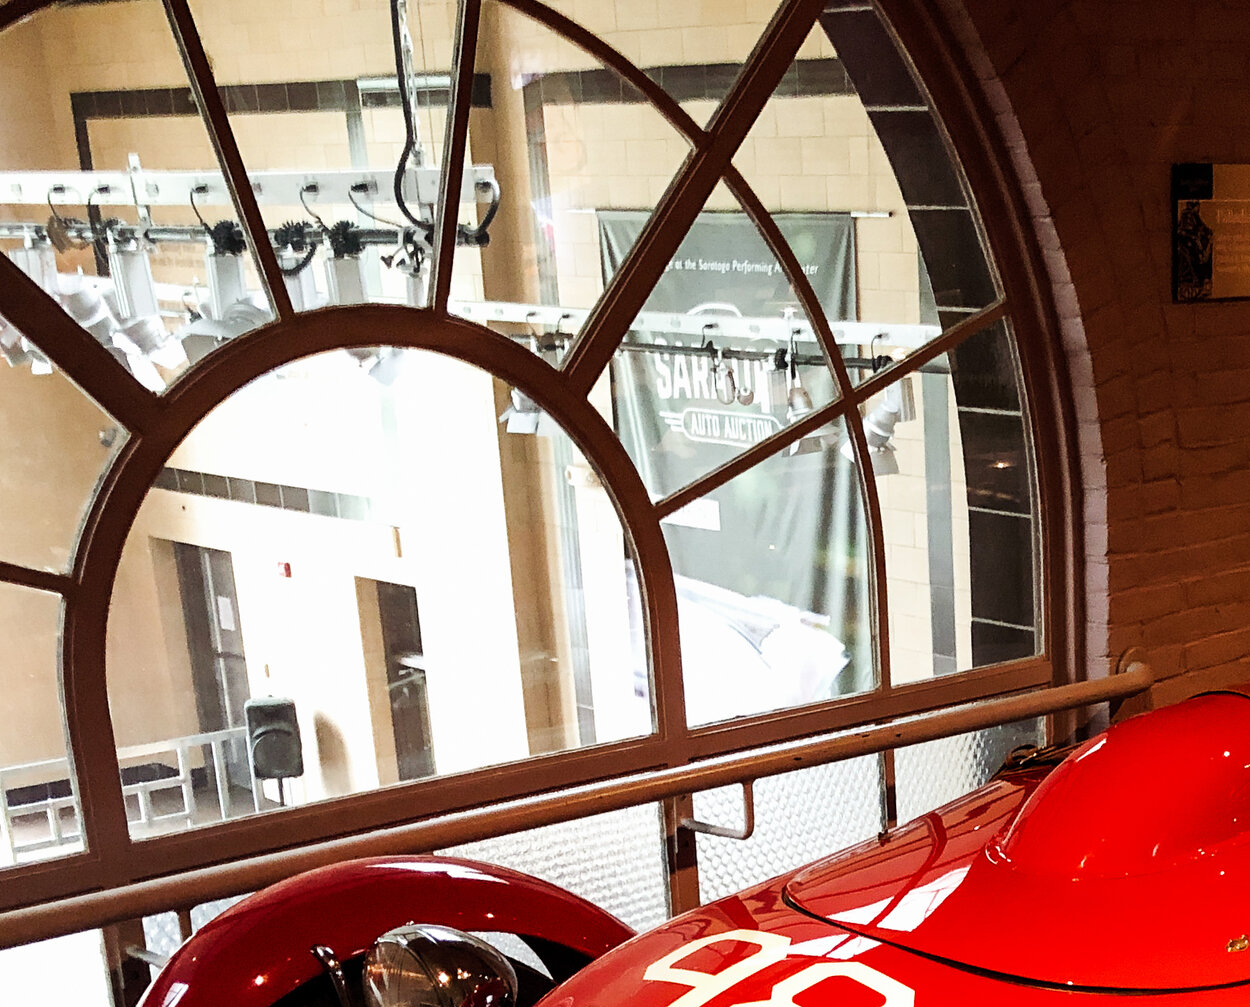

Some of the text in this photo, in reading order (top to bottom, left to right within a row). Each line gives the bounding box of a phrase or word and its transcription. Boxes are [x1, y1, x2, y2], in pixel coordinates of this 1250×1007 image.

[675, 260, 683, 270] at
[685, 259, 696, 270] the
[698, 259, 731, 274] Saratoga
[732, 260, 773, 276] Performing
[691, 412, 773, 442] AUTO AUCTION
